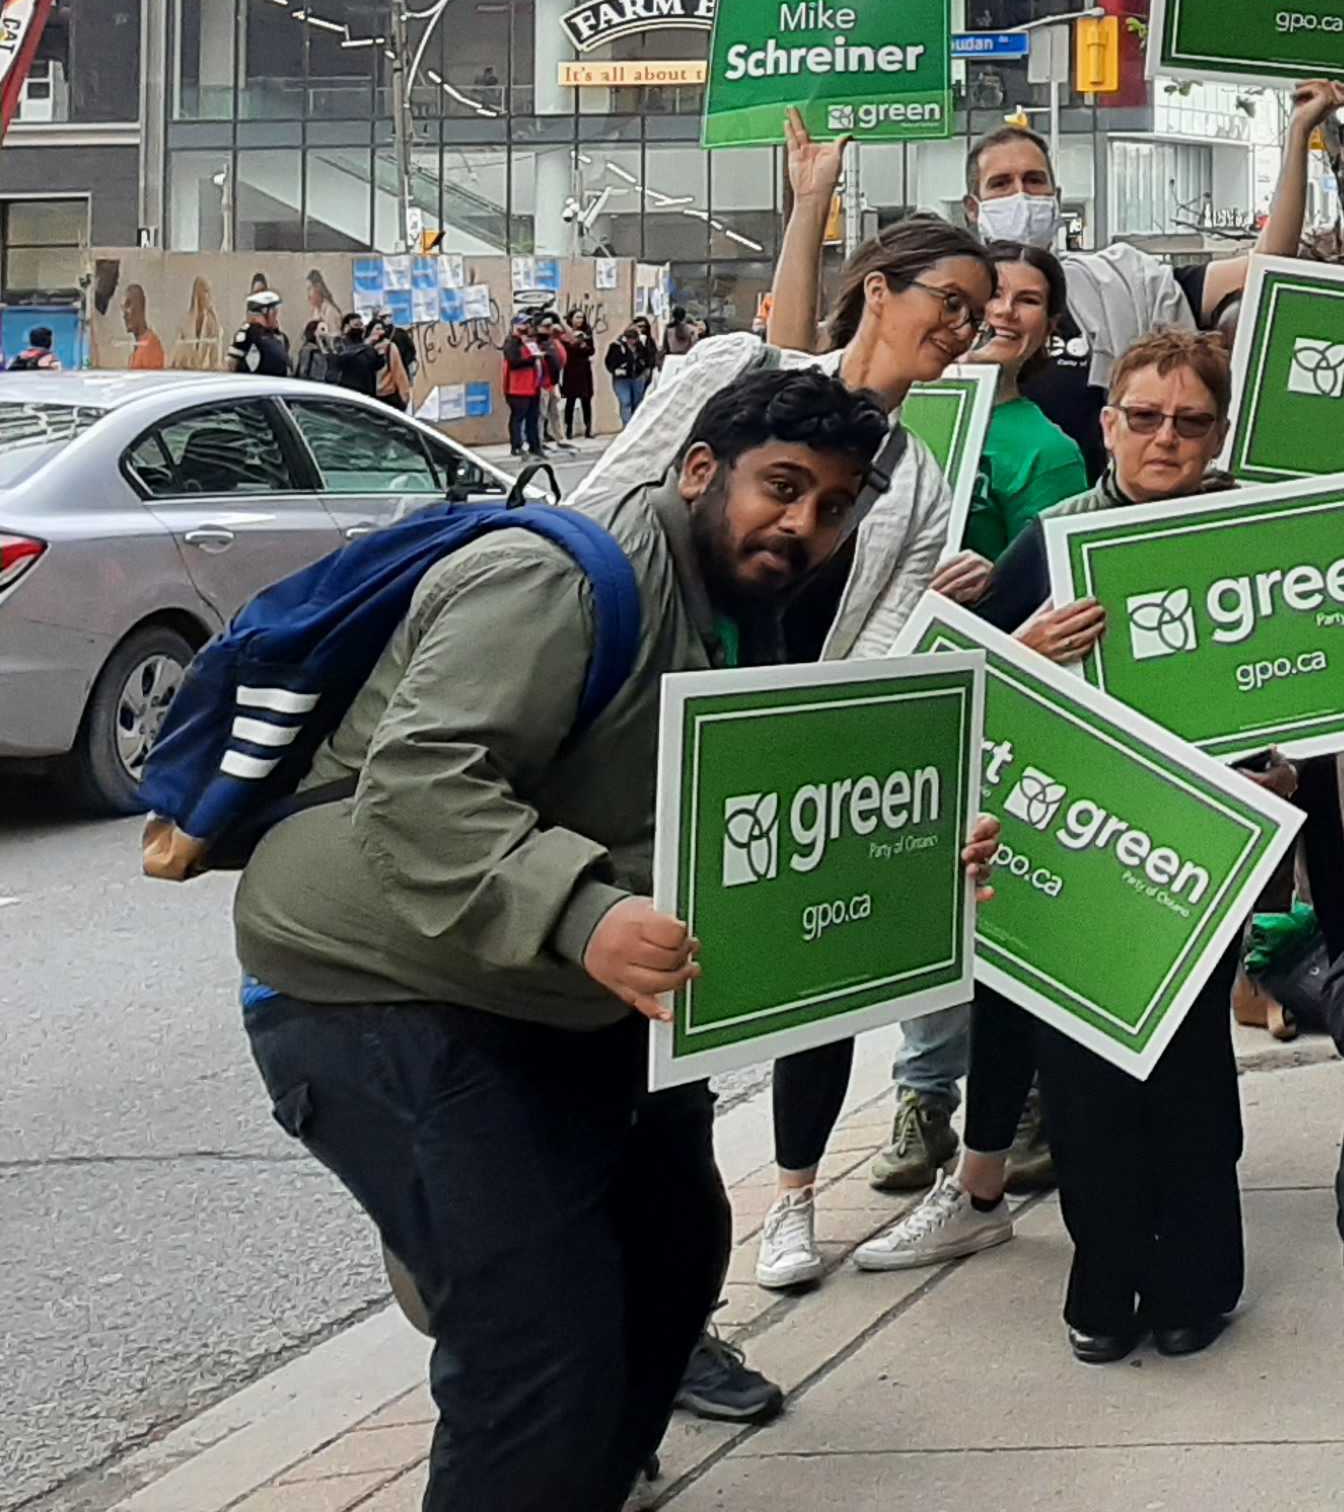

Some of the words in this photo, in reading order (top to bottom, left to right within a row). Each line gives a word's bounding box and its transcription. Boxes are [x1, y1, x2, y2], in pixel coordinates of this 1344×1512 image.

[0, 17, 21, 55] CAT
[1275, 10, 1344, 32] gpo.ca
[724, 35, 924, 80] Schreiner
[951, 37, 994, 51] udan
[565, 67, 592, 82] It's
[600, 67, 625, 81] all
[634, 67, 687, 81] about
[858, 102, 941, 129] green
[1235, 650, 1327, 691] gpo.ca
[790, 764, 939, 873] green
[990, 843, 1063, 898] po.ca
[1055, 799, 1211, 905] green
[802, 893, 871, 942] gpo.ca
